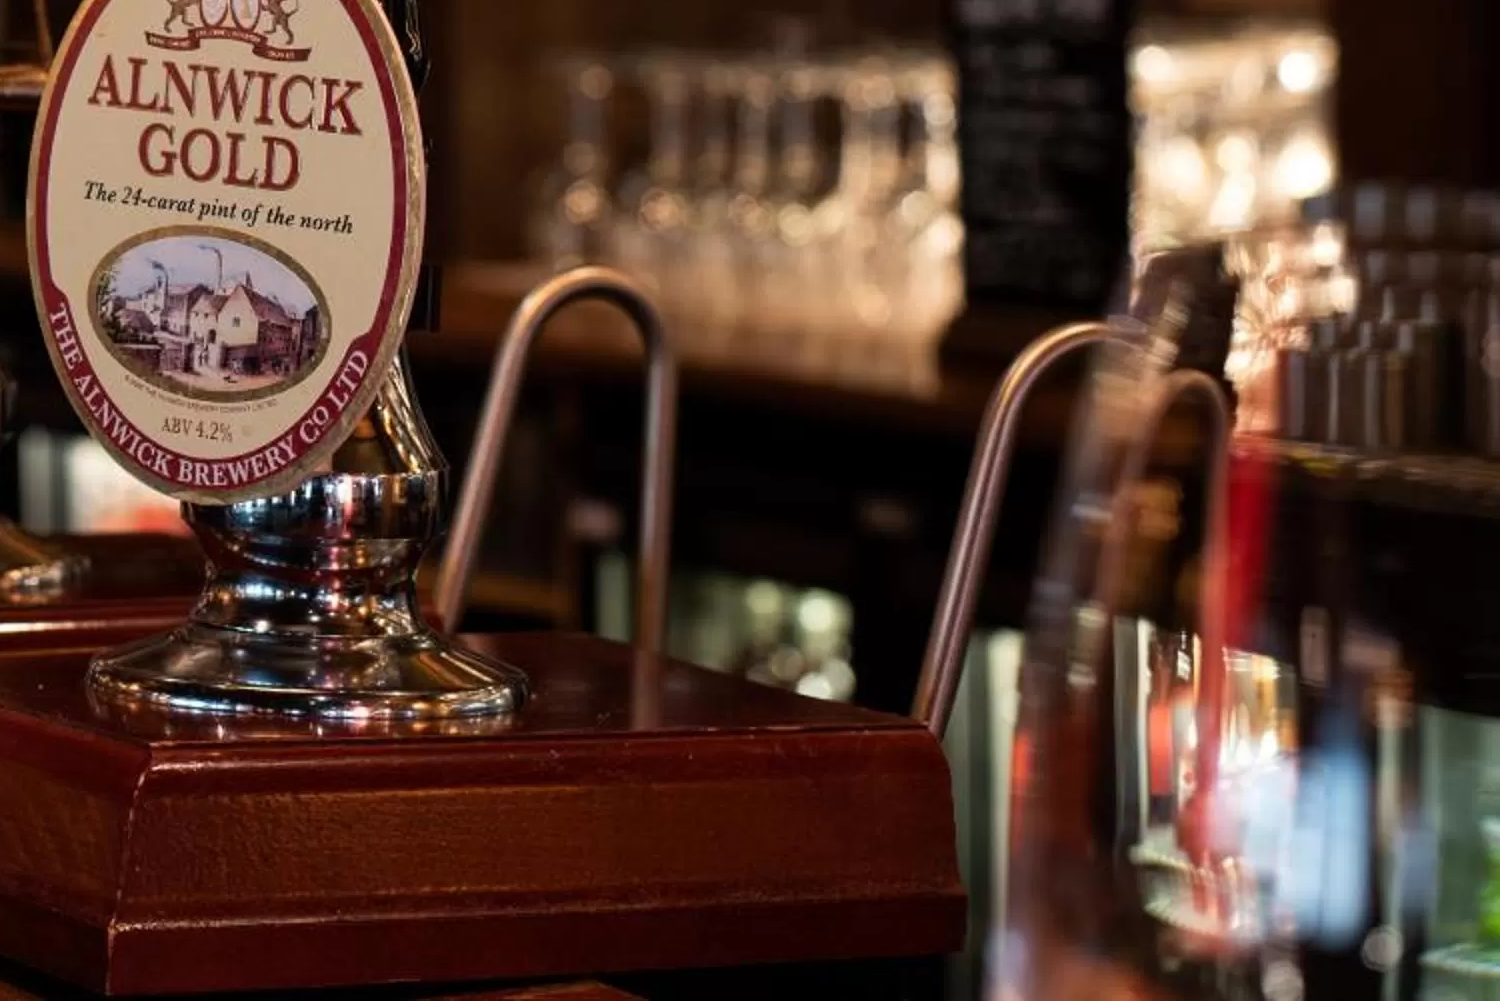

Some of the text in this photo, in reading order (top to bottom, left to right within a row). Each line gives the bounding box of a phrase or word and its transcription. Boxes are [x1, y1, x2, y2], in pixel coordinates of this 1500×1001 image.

[87, 53, 364, 136] ALNWICK
[137, 122, 300, 192] GOLD
[83, 180, 354, 235] The 24-carat pint of the north
[50, 302, 84, 371] THE
[72, 373, 176, 478] ALNWICK
[178, 434, 299, 487] BREWERY
[299, 405, 330, 445] CO
[327, 349, 369, 412] LTD
[161, 416, 234, 443] ABV 4.2%
